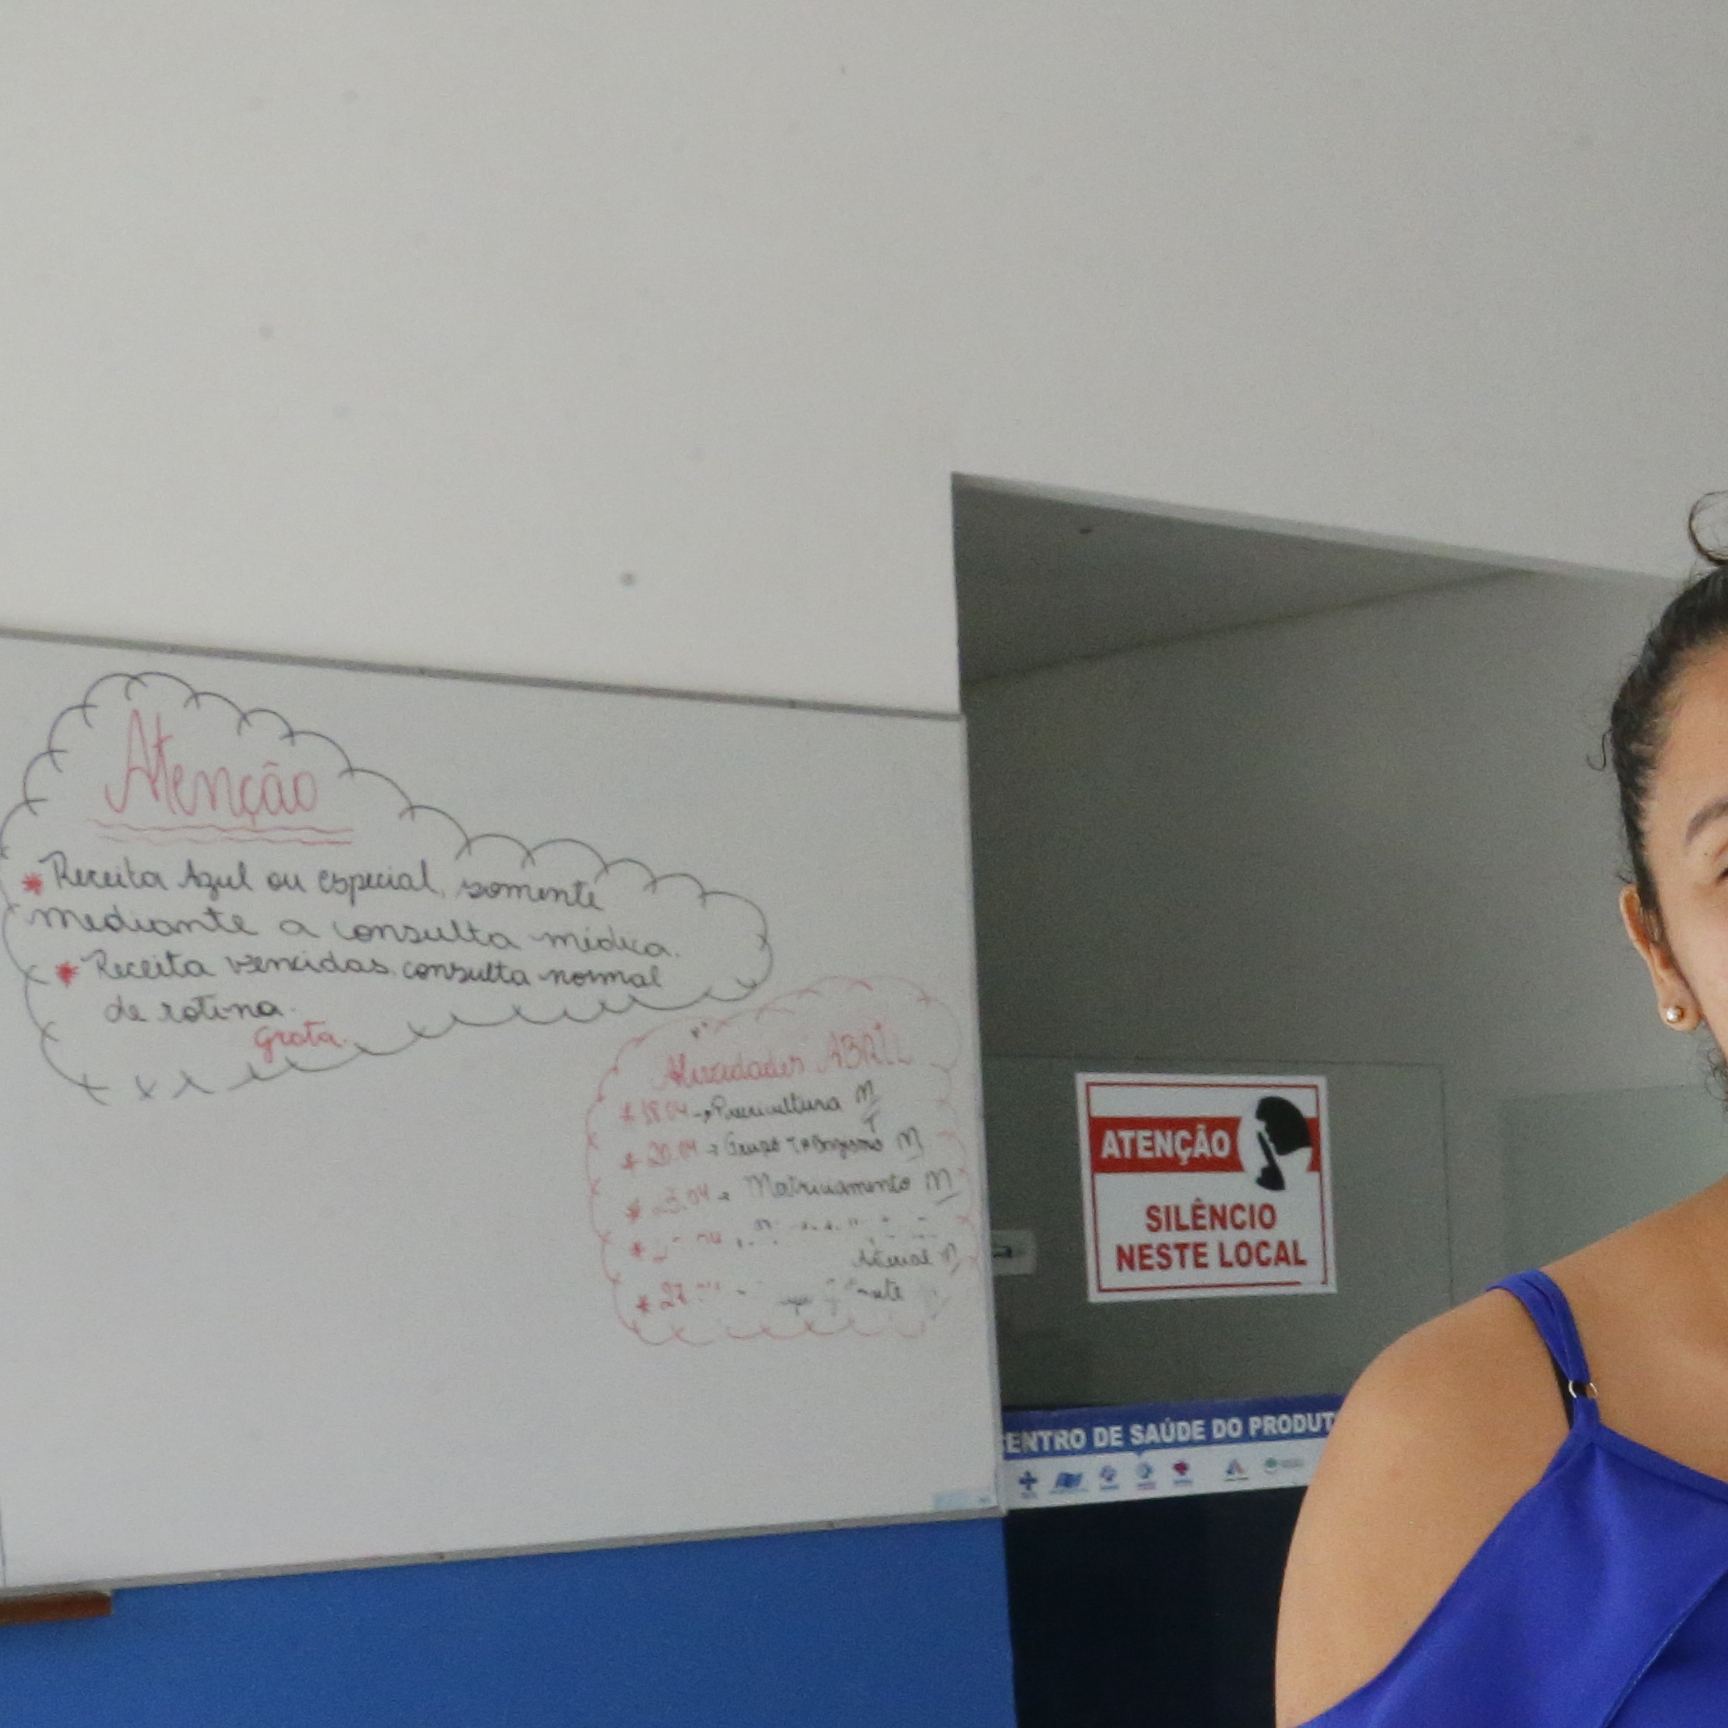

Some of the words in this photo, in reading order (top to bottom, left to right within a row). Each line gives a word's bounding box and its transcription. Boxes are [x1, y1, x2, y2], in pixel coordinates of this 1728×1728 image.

[104, 708, 319, 825] Atenção
[39, 850, 168, 890] Receita
[178, 857, 253, 900] Azul
[266, 871, 306, 892] ou
[456, 877, 604, 912] somente
[29, 905, 259, 936] mediante
[278, 918, 321, 939] a
[333, 918, 521, 951] consulta
[80, 949, 217, 979] Receita
[402, 953, 532, 987] consulta
[538, 963, 663, 989] normal
[103, 991, 148, 1023] de
[1101, 1123, 1231, 1166] ATENÇÃO
[1144, 1196, 1278, 1233] SILÊNCIO
[1115, 1241, 1209, 1272] NESTE
[1218, 1239, 1308, 1269] LOCAL
[1092, 1425, 1125, 1448] DE
[1128, 1418, 1206, 1446] SAÚDE
[1212, 1416, 1243, 1440] DO
[1249, 1410, 1336, 1437] PRODUT
